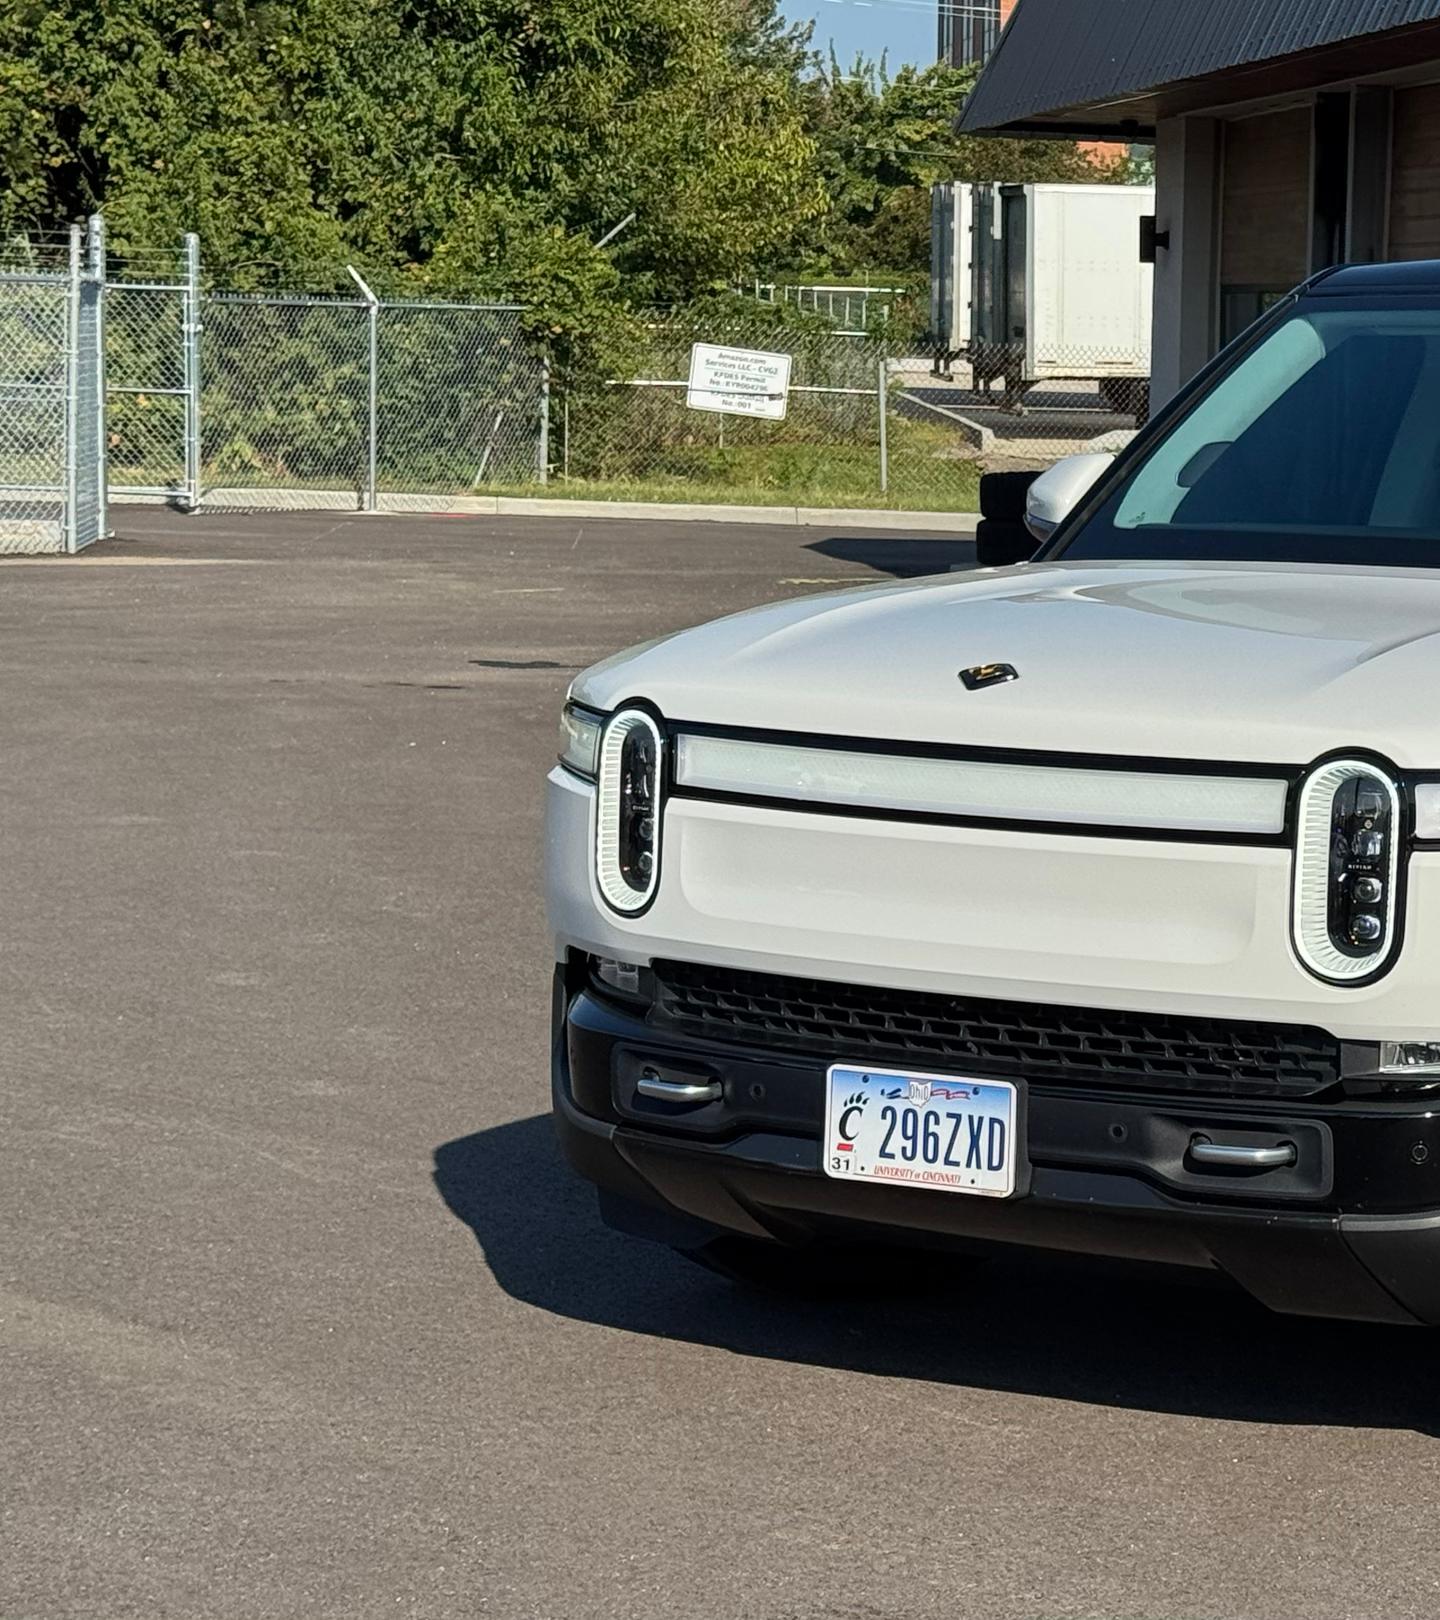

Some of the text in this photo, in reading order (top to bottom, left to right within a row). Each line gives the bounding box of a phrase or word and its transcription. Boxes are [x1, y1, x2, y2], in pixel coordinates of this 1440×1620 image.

[705, 358, 736, 369] Services
[737, 363, 751, 371] LLC
[718, 352, 766, 364] Amazon.com
[740, 374, 766, 383] Permit
[878, 1105, 1006, 1172] 296ZXD
[831, 1156, 850, 1171] 31
[873, 1164, 915, 1178] UNIVERSITY
[922, 1171, 962, 1185] CINCINNATI
